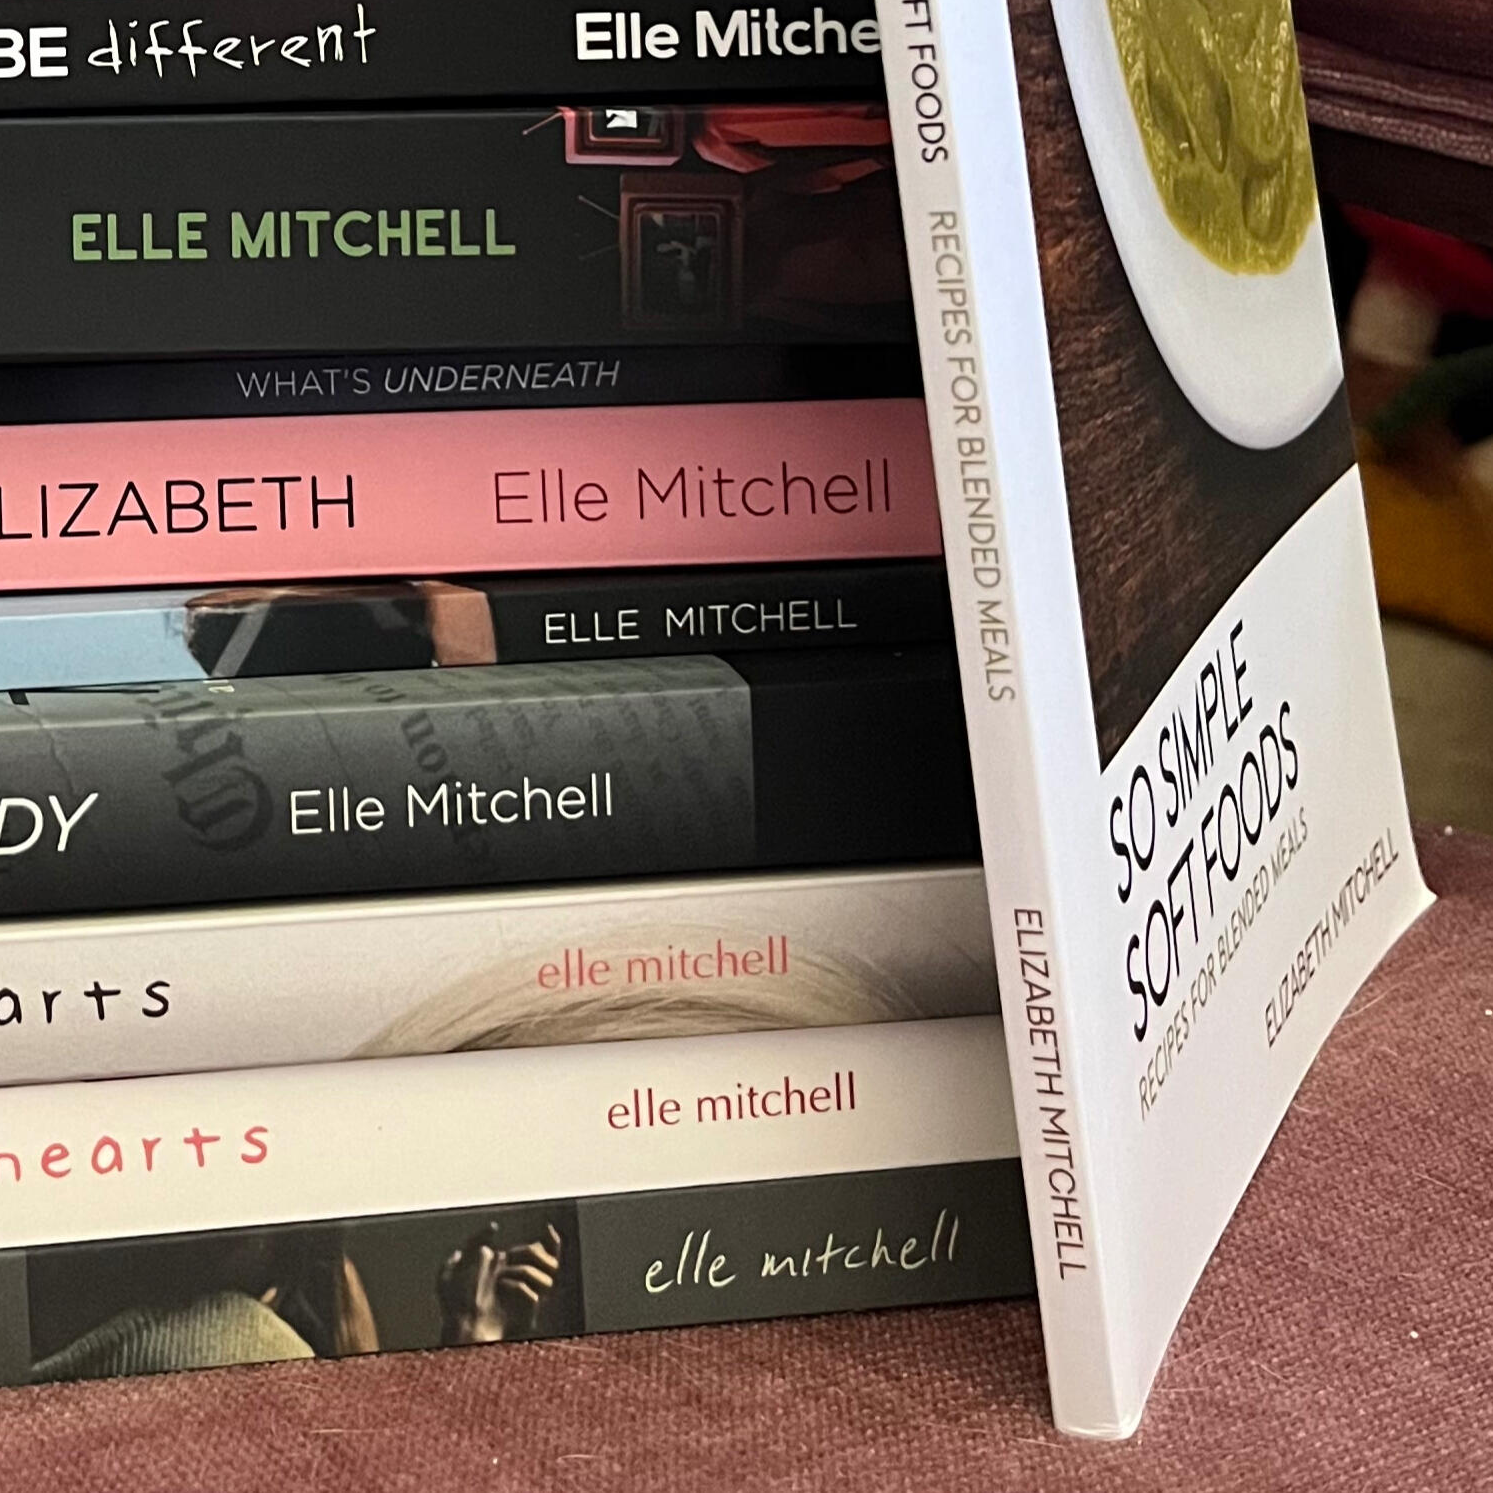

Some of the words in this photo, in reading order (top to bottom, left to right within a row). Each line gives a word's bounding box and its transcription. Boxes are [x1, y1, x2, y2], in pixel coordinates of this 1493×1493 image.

[86, 3, 377, 80] different
[576, 12, 679, 60] Elle
[695, 8, 883, 58] Mitche
[907, 45, 949, 164] FOODS
[71, 212, 208, 262] ELLE
[230, 209, 516, 259] MITCHELL
[928, 210, 973, 346] RECIPES
[236, 368, 371, 399] WHAT'S
[383, 361, 620, 395] UNDERNEATH
[947, 355, 981, 426] FOR
[494, 468, 609, 524] Elle
[637, 458, 892, 520] Mitchell
[957, 437, 1001, 589] BLENDED
[544, 609, 640, 644] ELLE
[665, 599, 858, 637] MITCHELL
[977, 601, 1015, 703] MEALS
[1110, 764, 1156, 904] SO
[1159, 618, 1254, 828] SIMPLE
[290, 787, 385, 835] Elle
[407, 772, 613, 829] Mitchell
[1126, 842, 1200, 1042] SOFT
[1201, 701, 1299, 917] FOODS
[537, 949, 611, 991] elle
[626, 935, 790, 985] mitchell
[1139, 1002, 1189, 1122] RECIPES
[1190, 963, 1217, 1024] FOR
[1218, 877, 1270, 977] BLENDED
[1270, 806, 1308, 889] MEALS
[1265, 914, 1332, 1049] ELIZABETH
[1331, 827, 1399, 940] MITCHELL
[607, 1086, 683, 1132] elle
[697, 1072, 857, 1123] mitchell
[1013, 908, 1064, 1096] ELIZABETH
[1040, 1106, 1087, 1280] MITCHELL
[644, 1231, 738, 1293] elle
[761, 1210, 960, 1279] mitchell
